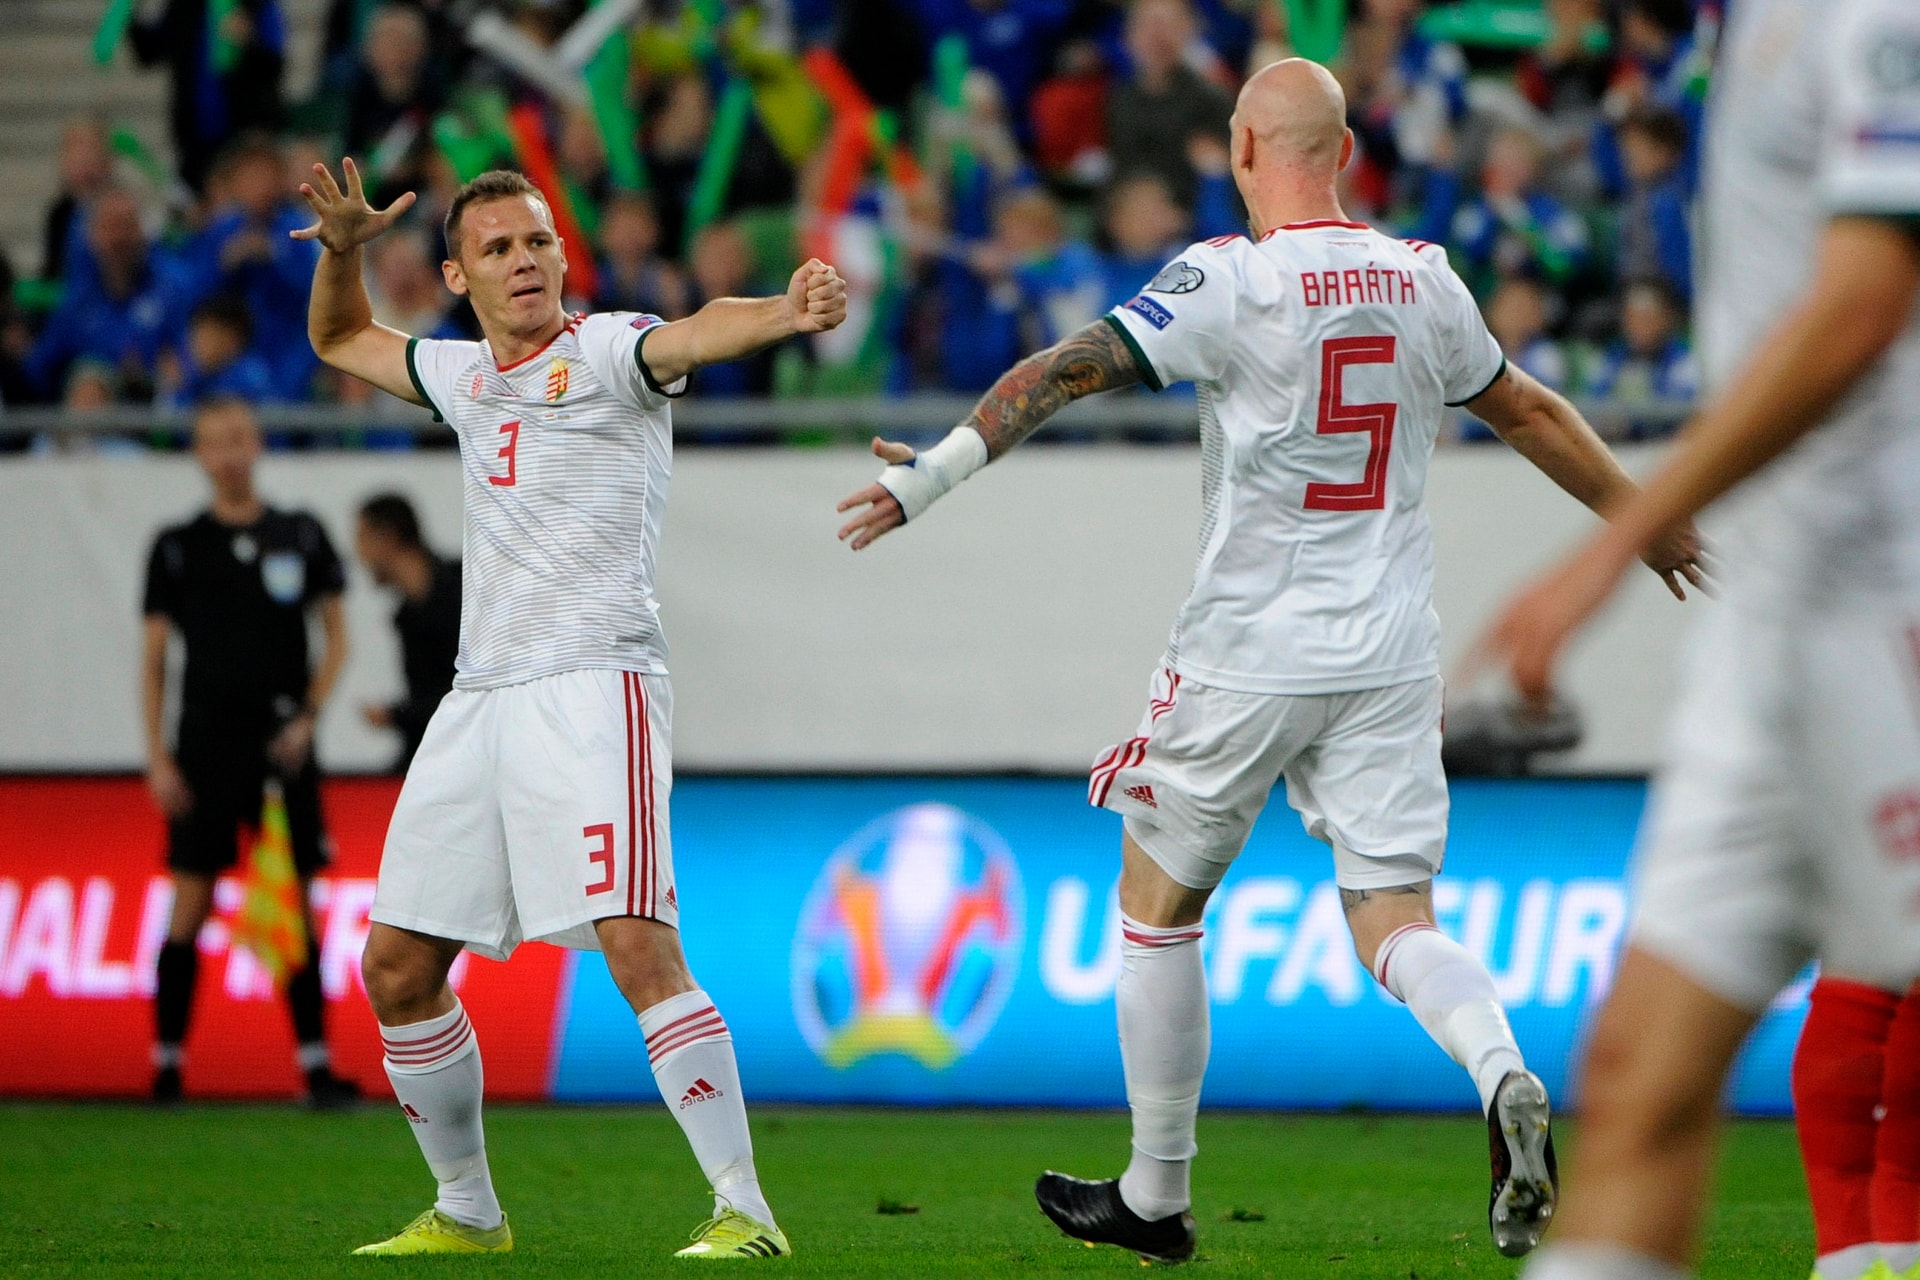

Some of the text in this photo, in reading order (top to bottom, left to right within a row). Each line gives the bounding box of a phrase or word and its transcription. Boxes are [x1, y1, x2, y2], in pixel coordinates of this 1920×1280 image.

[1301, 261, 1416, 307] BARÁTH
[488, 420, 521, 487] 3
[1303, 336, 1397, 511] 5
[583, 823, 615, 897] 3
[1038, 874, 1405, 1006] UFA
[680, 1089, 724, 1110] adidas
